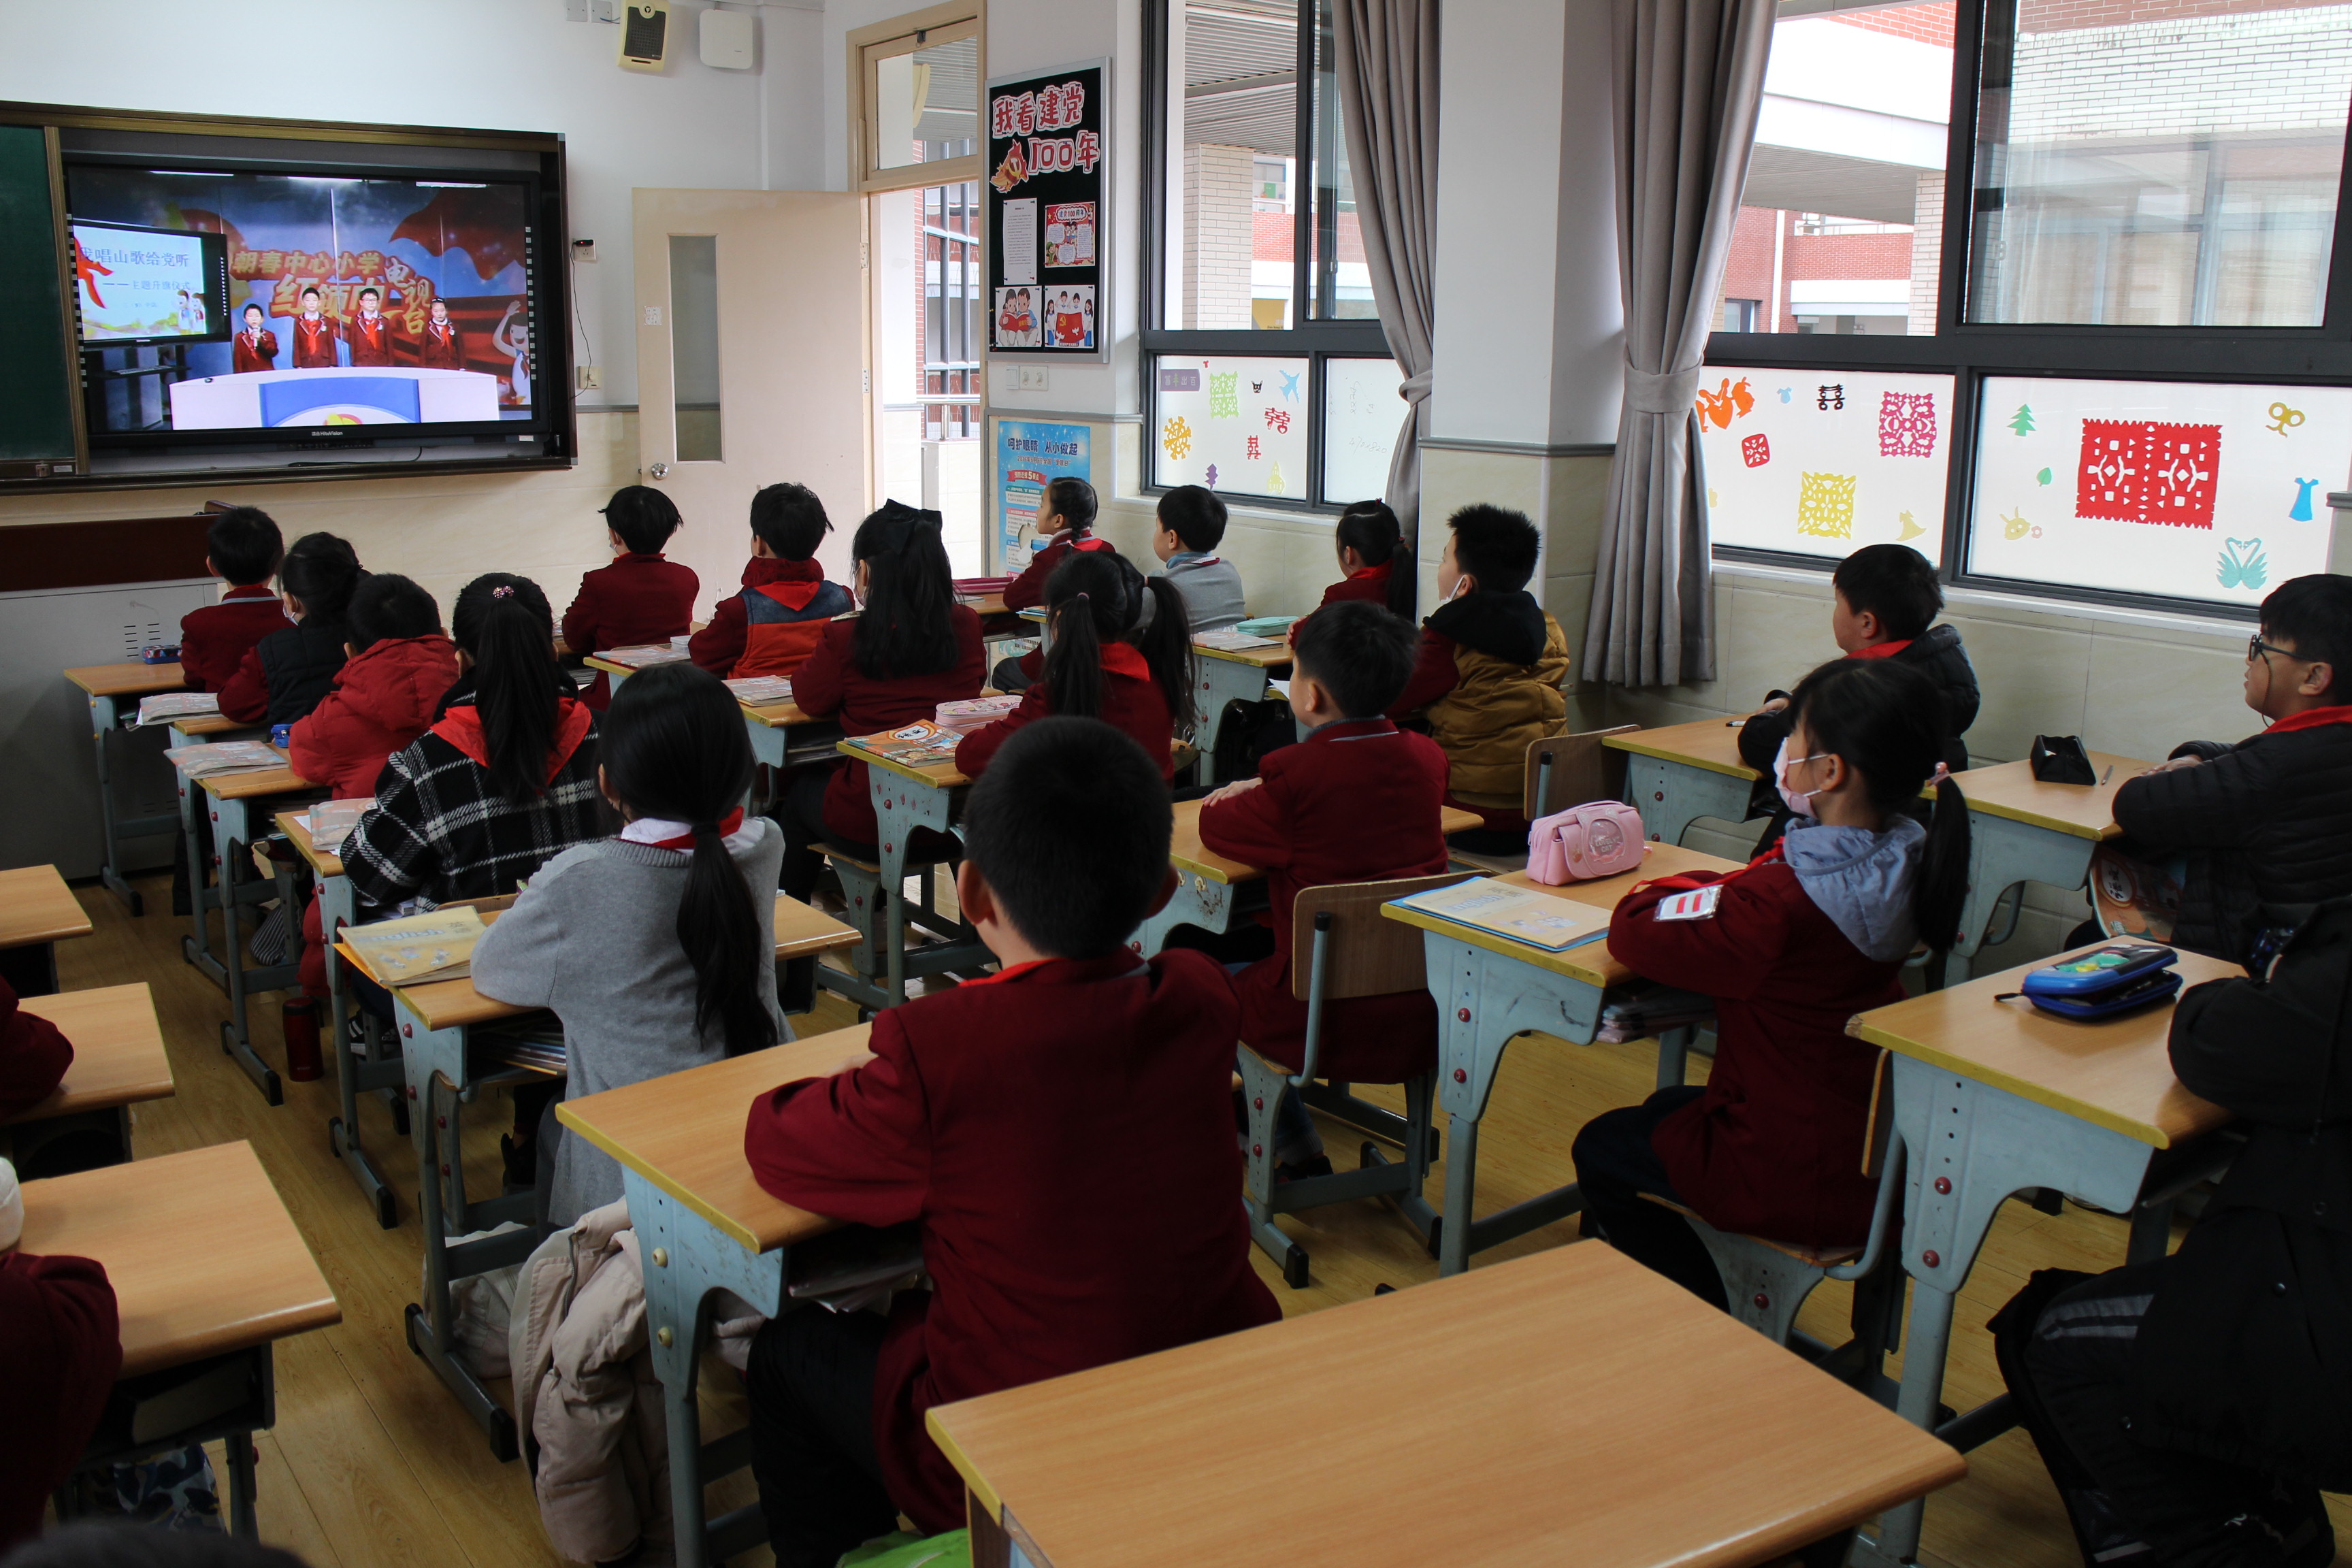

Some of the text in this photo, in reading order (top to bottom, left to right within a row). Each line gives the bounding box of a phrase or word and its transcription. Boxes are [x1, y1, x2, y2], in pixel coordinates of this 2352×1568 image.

[994, 82, 1083, 136] 我看建党
[1029, 131, 1098, 172] 100年
[232, 252, 380, 274] 朝春中心小学
[1007, 438, 1077, 455] 呵护眼睛 从小做起
